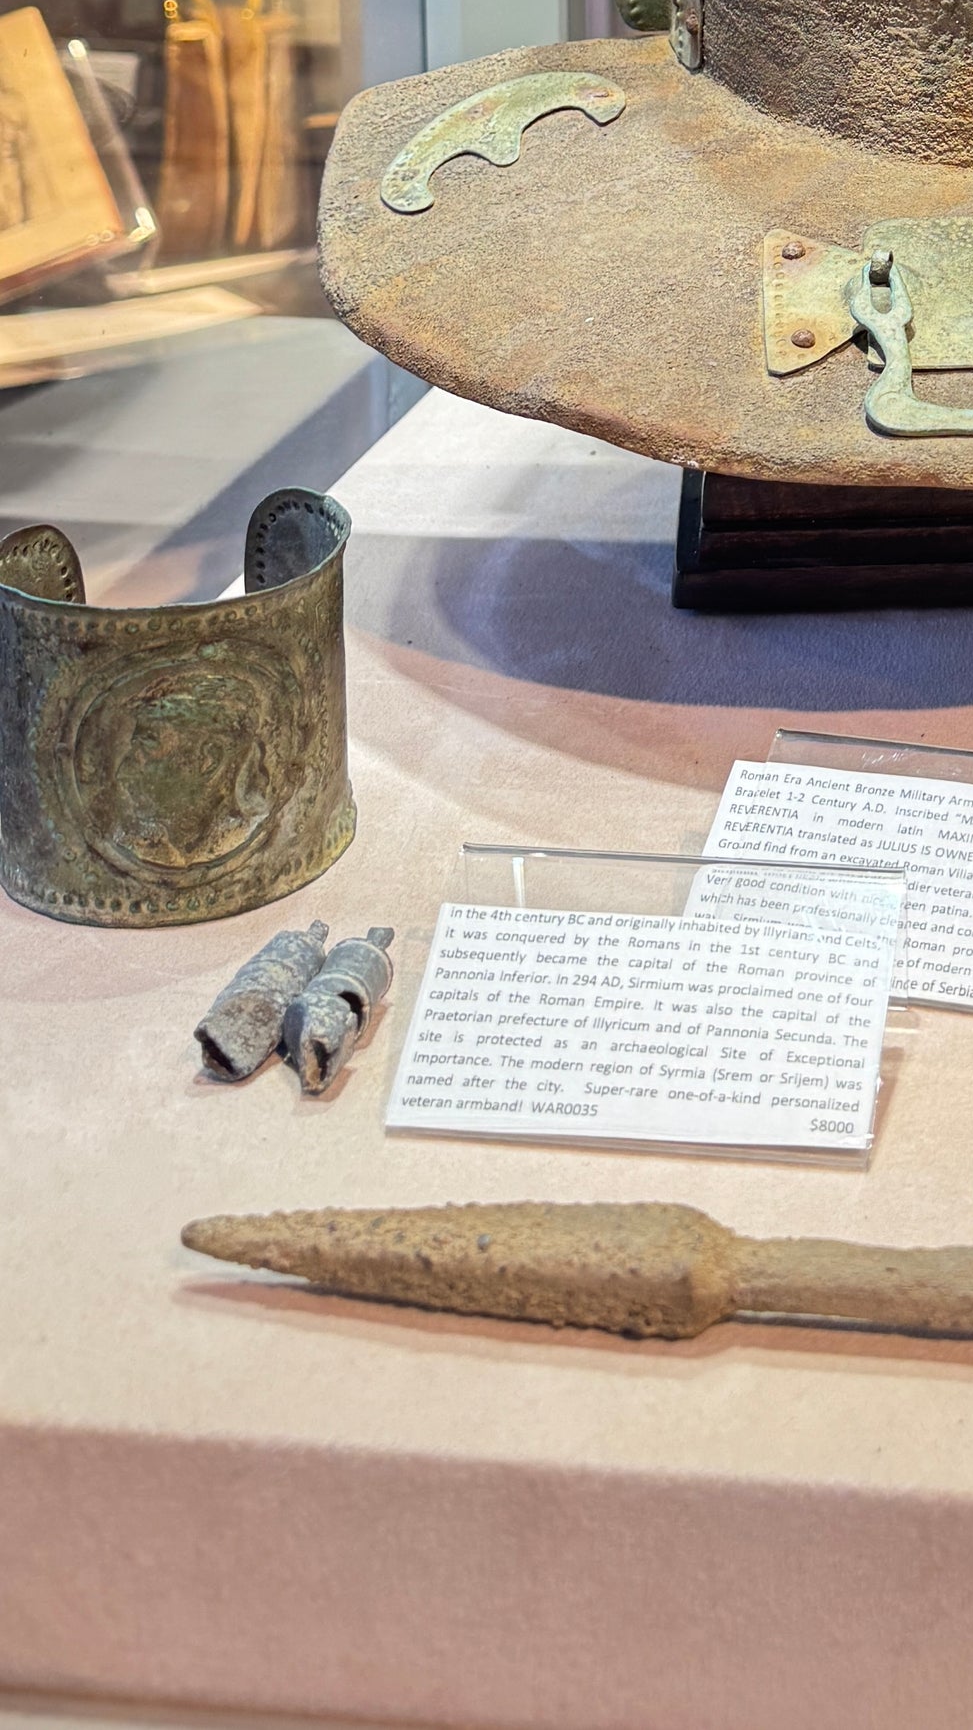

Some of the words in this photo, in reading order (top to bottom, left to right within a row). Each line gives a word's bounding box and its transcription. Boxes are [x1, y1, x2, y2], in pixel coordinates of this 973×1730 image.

[783, 773, 802, 785] Era
[805, 777, 850, 792] Ancient
[854, 783, 895, 798] Bronze
[899, 788, 946, 805] Military
[786, 791, 805, 803] 1-2
[811, 794, 858, 812] Century
[861, 801, 886, 814] A.D.
[812, 812, 824, 823] in
[837, 818, 884, 832] modern
[797, 829, 858, 846] translated
[860, 839, 873, 848] as
[876, 839, 918, 854] JULIUS
[920, 845, 932, 856] IS
[763, 841, 786, 854] find
[789, 843, 818, 858] from
[821, 851, 836, 861] an
[903, 861, 945, 876] Roman
[948, 867, 973, 881] Villa
[445, 926, 455, 939] it
[463, 930, 488, 940] was
[495, 932, 566, 945] conquered
[573, 933, 590, 948] by
[597, 934, 620, 947] the
[627, 936, 680, 951] Romans
[688, 940, 701, 951] in
[710, 941, 732, 954] the
[740, 944, 760, 956] 1st
[768, 948, 820, 964] century
[828, 953, 846, 965] BC
[854, 958, 879, 969] and
[435, 967, 495, 981] Pannonia
[499, 970, 551, 985] Inferior.
[556, 973, 569, 985] In
[572, 974, 597, 987] 294
[600, 976, 624, 990] AD,
[627, 977, 684, 991] Sirmium
[688, 983, 714, 994] was
[717, 984, 794, 999] proclaimed
[797, 991, 823, 1002] one
[827, 992, 842, 1004] of
[845, 993, 873, 1007] four
[413, 1051, 492, 1066] Importance.
[501, 1055, 525, 1069] The
[530, 1058, 584, 1071] modern
[589, 1061, 633, 1076] region
[639, 1063, 655, 1076] of
[658, 1064, 706, 1079] Syrmia
[712, 1067, 753, 1083] (Srem
[759, 1073, 775, 1083] or
[835, 1080, 862, 1091] was
[402, 1096, 453, 1108] veteran
[455, 1097, 523, 1113] armband!
[531, 1101, 598, 1117] WAR0035
[407, 1073, 454, 1087] named
[462, 1075, 496, 1089] after
[505, 1077, 528, 1091] the
[536, 1079, 564, 1095] city.
[584, 1082, 658, 1098] Super-rare
[667, 1089, 762, 1105] one-of-a-kind
[771, 1096, 860, 1113] personalized
[809, 1118, 854, 1134] $8000
